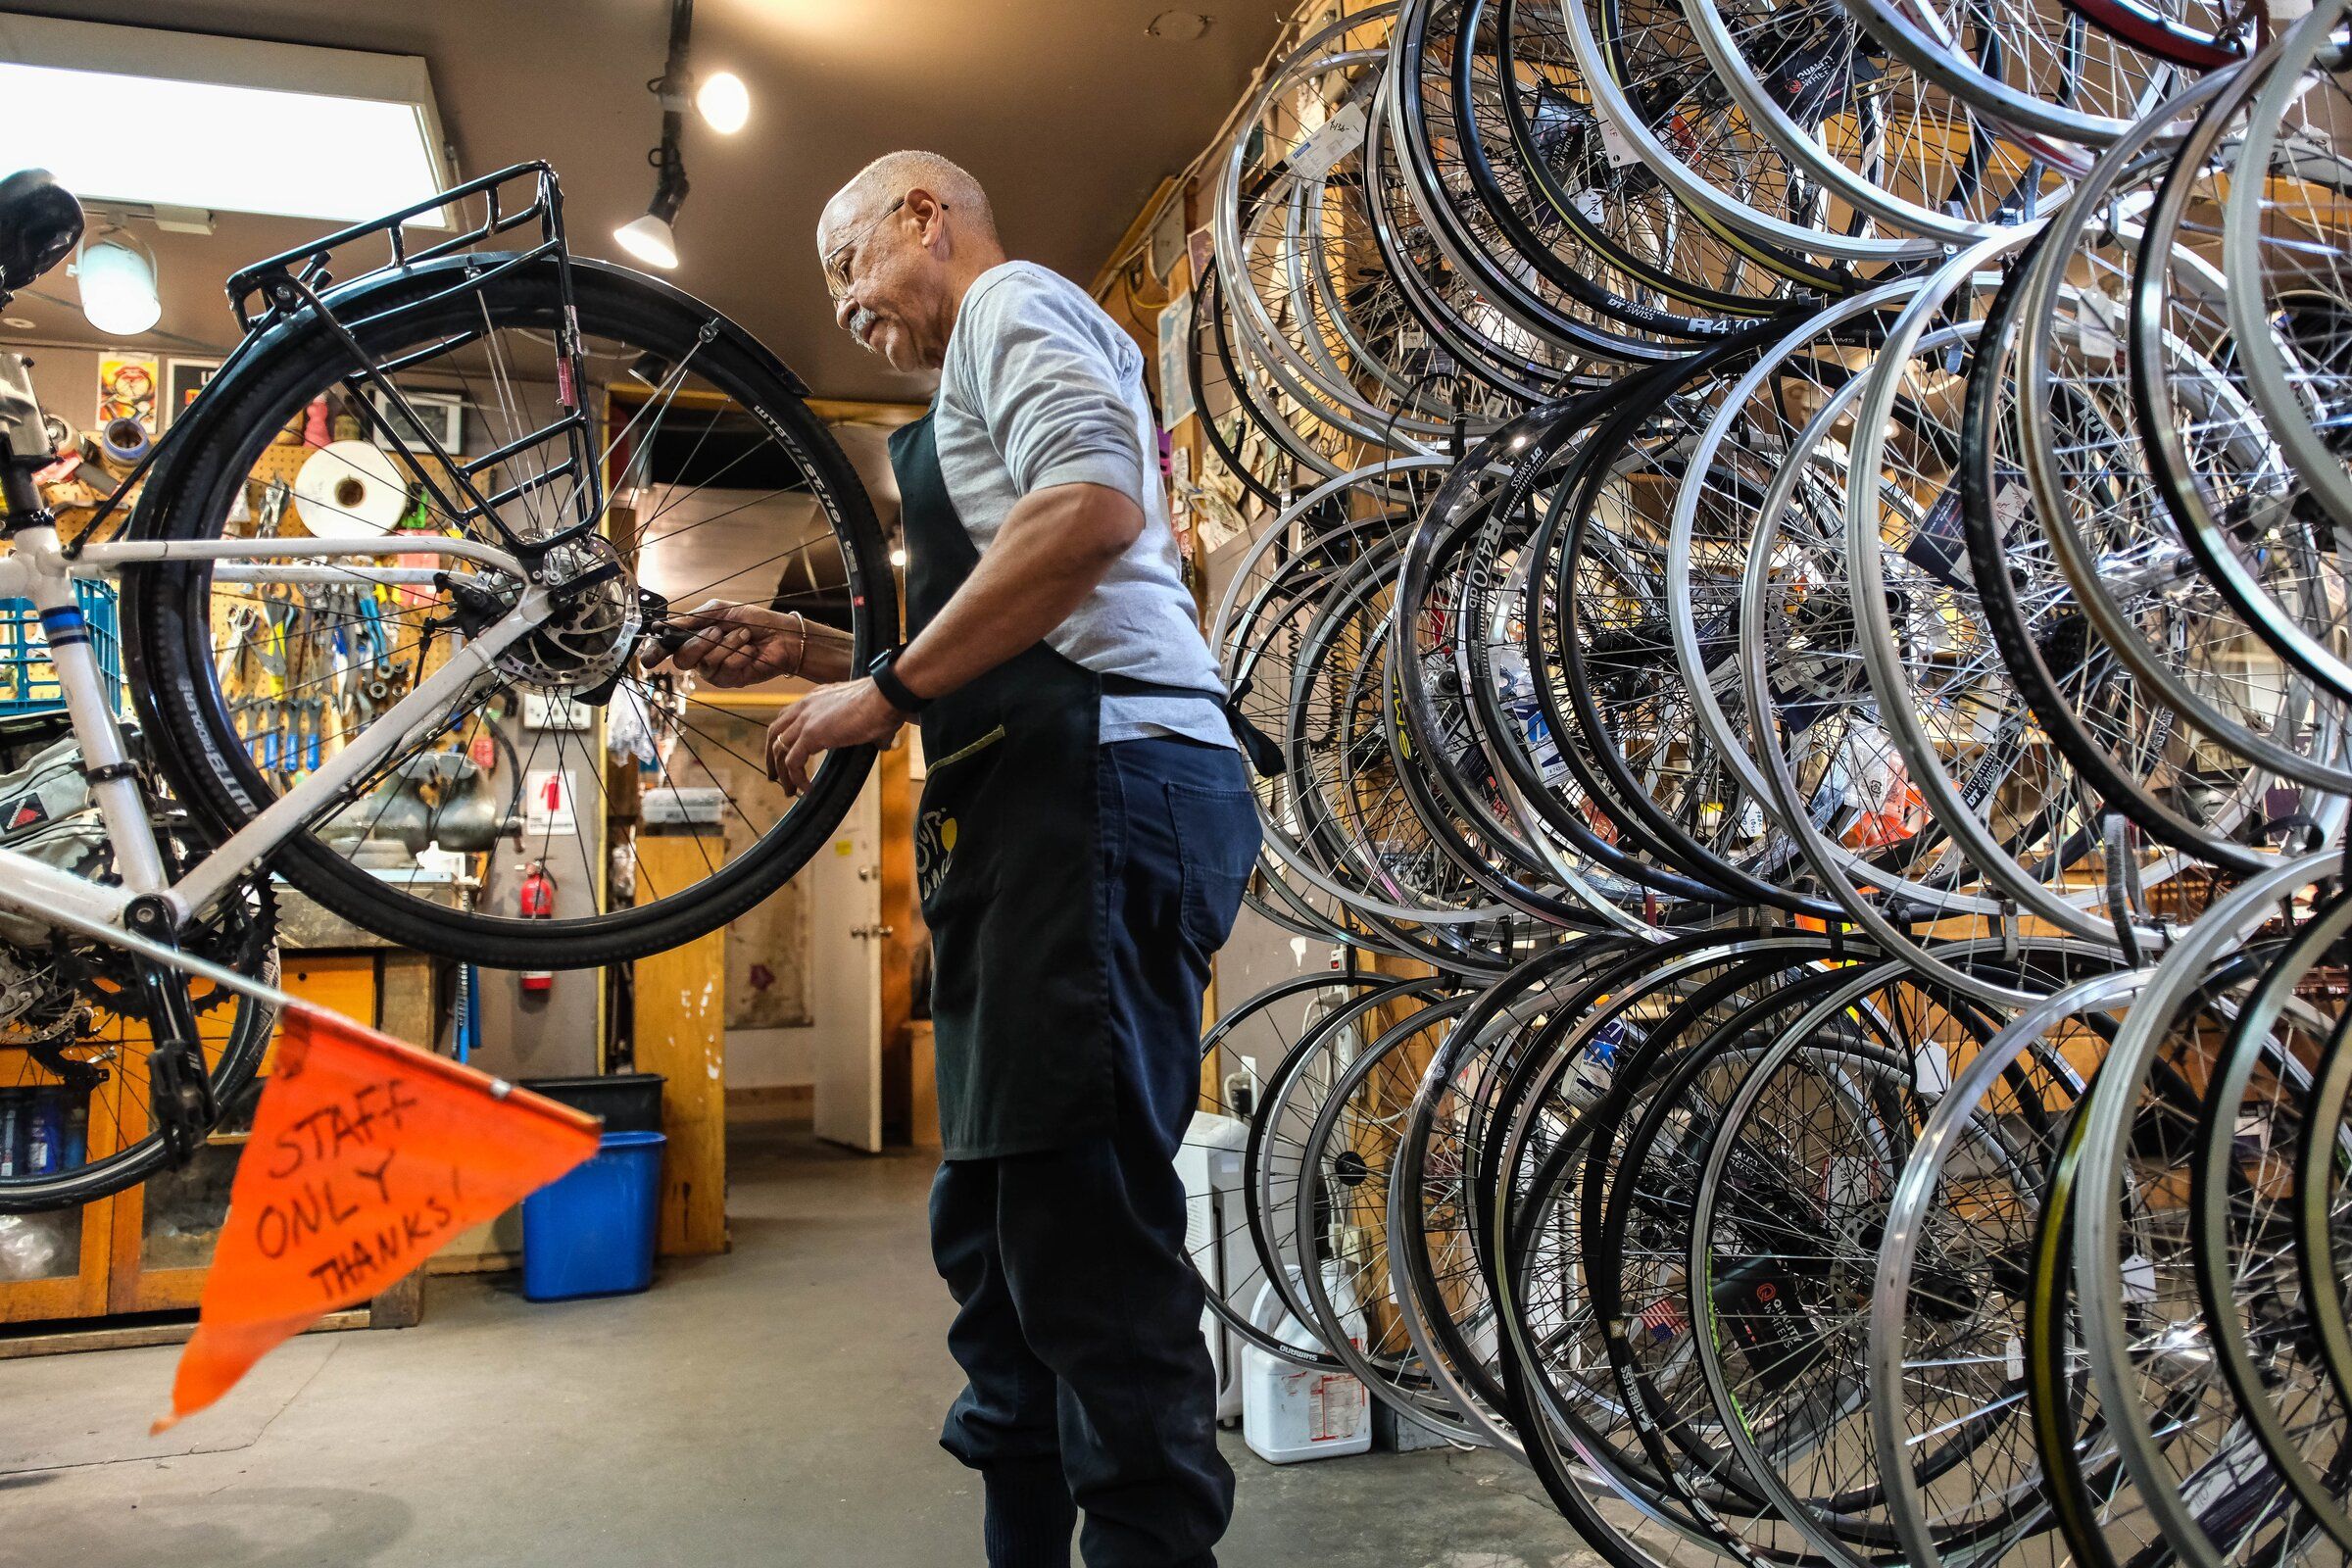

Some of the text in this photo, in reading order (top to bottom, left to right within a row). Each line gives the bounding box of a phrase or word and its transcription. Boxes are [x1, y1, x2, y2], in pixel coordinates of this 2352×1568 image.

[1606, 298, 1655, 321] DT SWISS
[753, 405, 786, 438] WTB
[1510, 446, 1544, 489] DT SWISS
[1966, 788, 1982, 808] DT
[1978, 761, 2000, 792] SWISS
[269, 1079, 417, 1179] STAFF
[256, 1148, 395, 1259] ONLY
[308, 1165, 468, 1299] THANKS!
[1279, 1344, 1318, 1362] SHIMANO
[1620, 1364, 1643, 1416] TUBELESS
